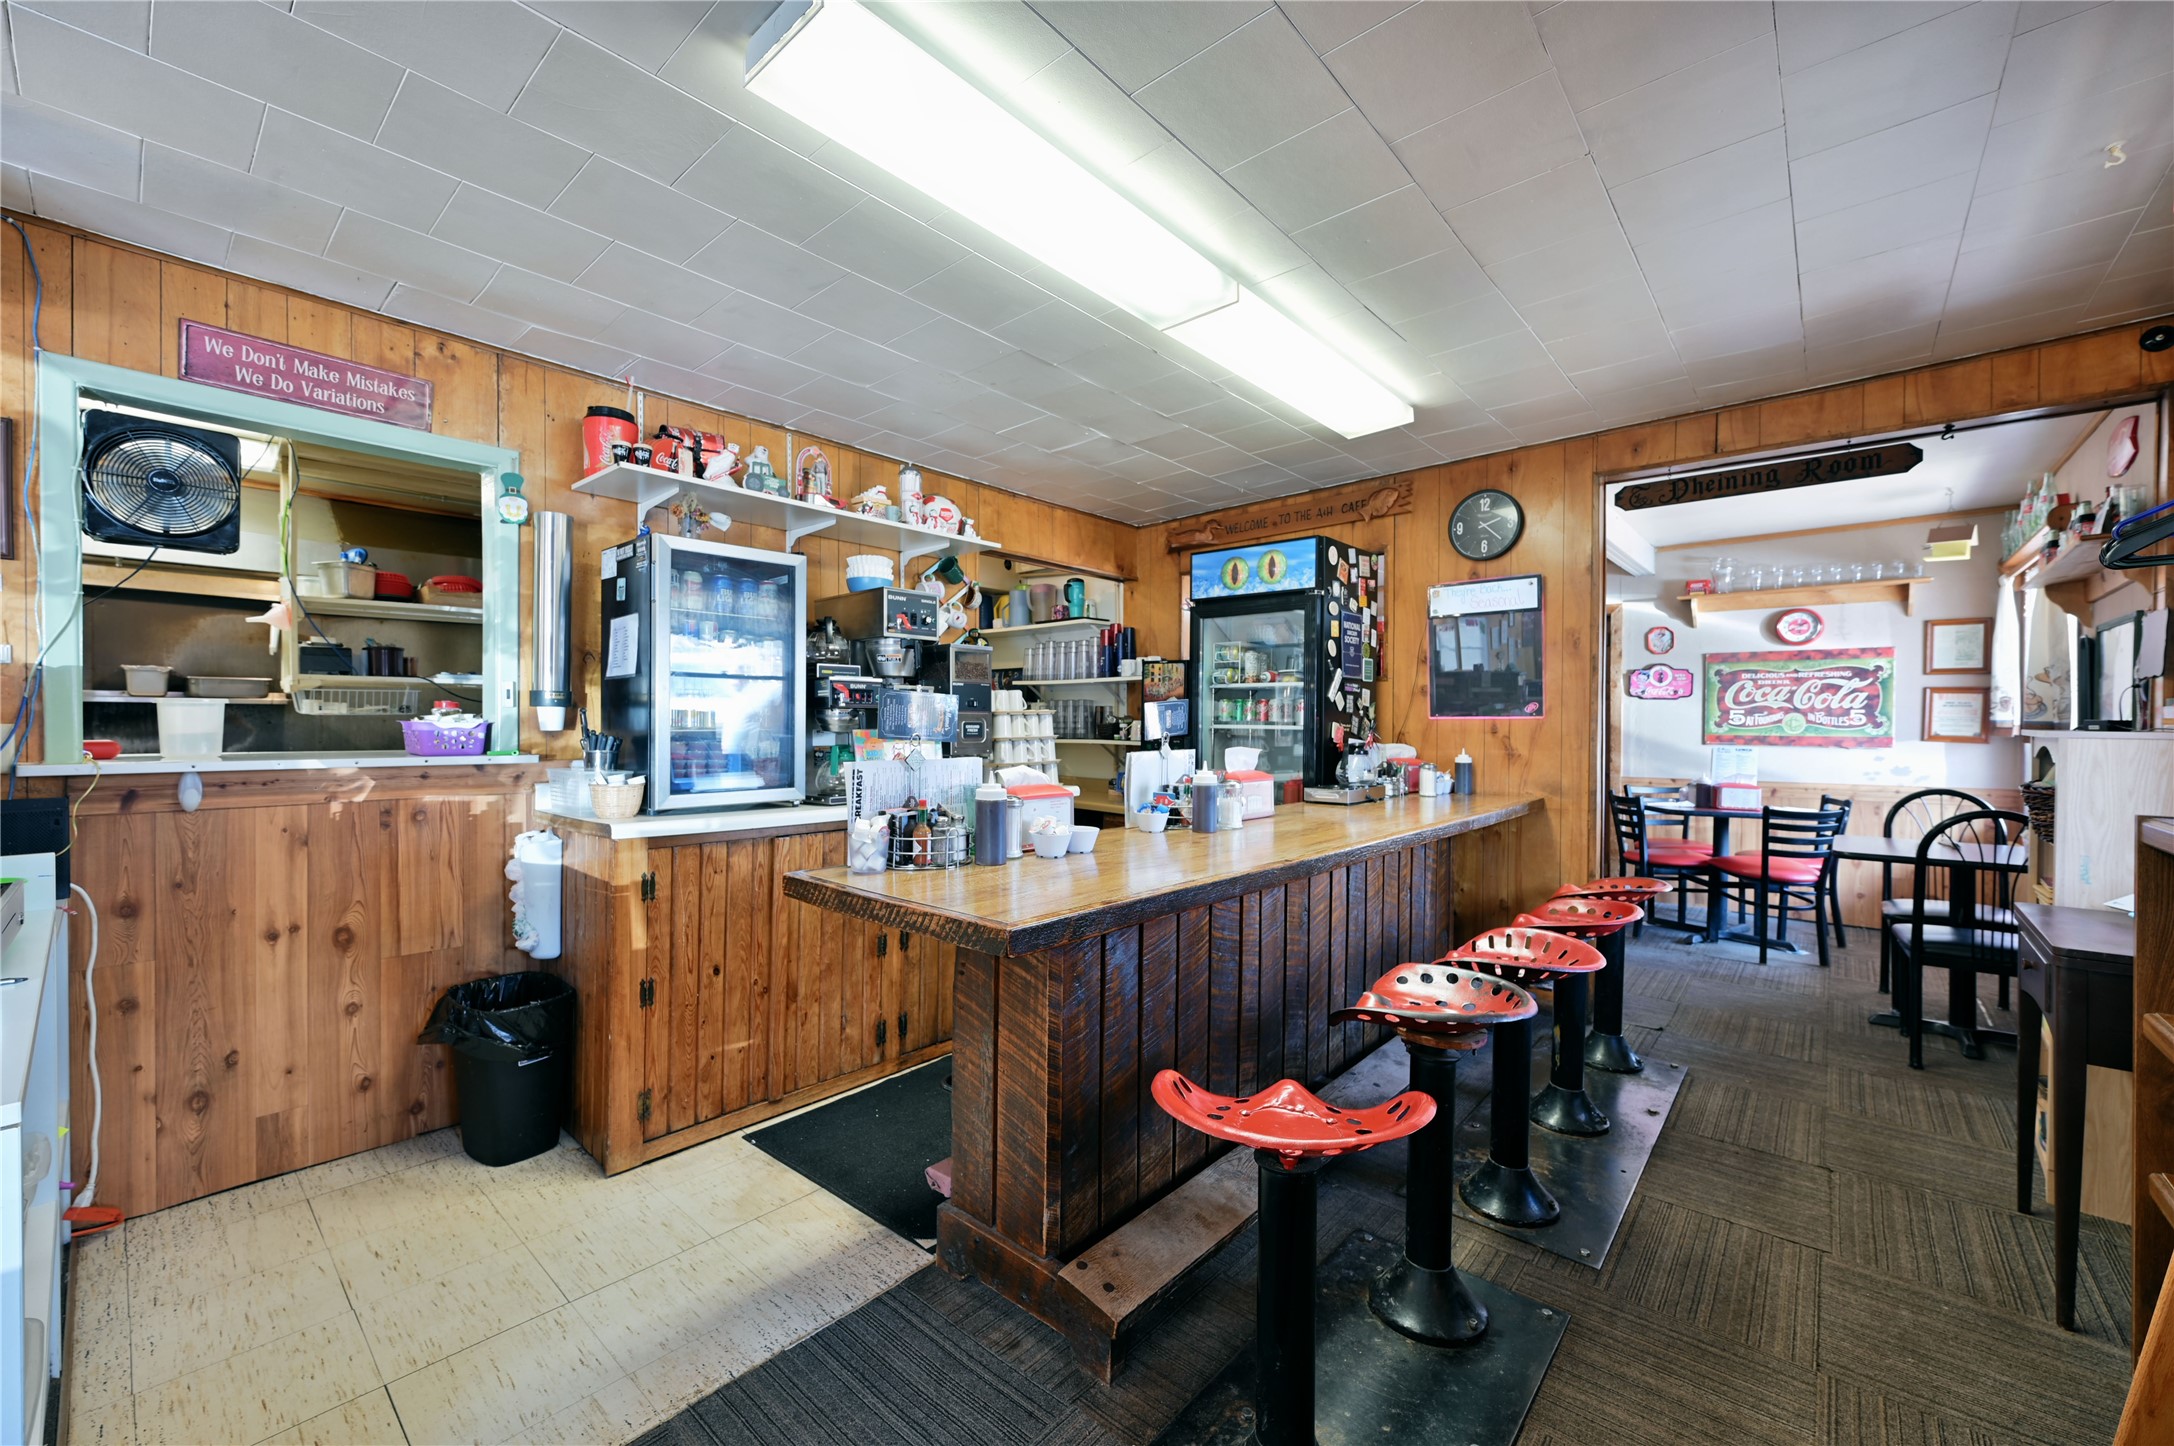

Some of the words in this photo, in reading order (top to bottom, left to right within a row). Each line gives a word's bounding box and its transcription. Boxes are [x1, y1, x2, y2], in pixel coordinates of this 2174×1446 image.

[204, 335, 234, 357] We
[241, 345, 286, 371] Don't
[294, 358, 340, 383] Make
[346, 371, 416, 401] Mistakes
[234, 365, 264, 386] We
[271, 374, 294, 393] Do
[301, 380, 385, 414] Variations
[1794, 451, 1884, 484] Room
[1479, 497, 1491, 512] 12
[1224, 516, 1269, 536] WELCOME
[1278, 512, 1291, 525] TO
[1293, 508, 1312, 522] THE
[1456, 522, 1463, 535] 9
[1507, 514, 1514, 529] 3
[1481, 540, 1488, 553] 6
[887, 594, 907, 602] BUNN
[1343, 621, 1361, 631] NATIONAL
[1344, 635, 1360, 645] SOCIETY
[1798, 670, 1853, 678] REFRESHING
[1724, 677, 1873, 709] Coca-Cola
[1815, 711, 1850, 726] BOTTLES
[854, 768, 863, 822] REAKFAST
